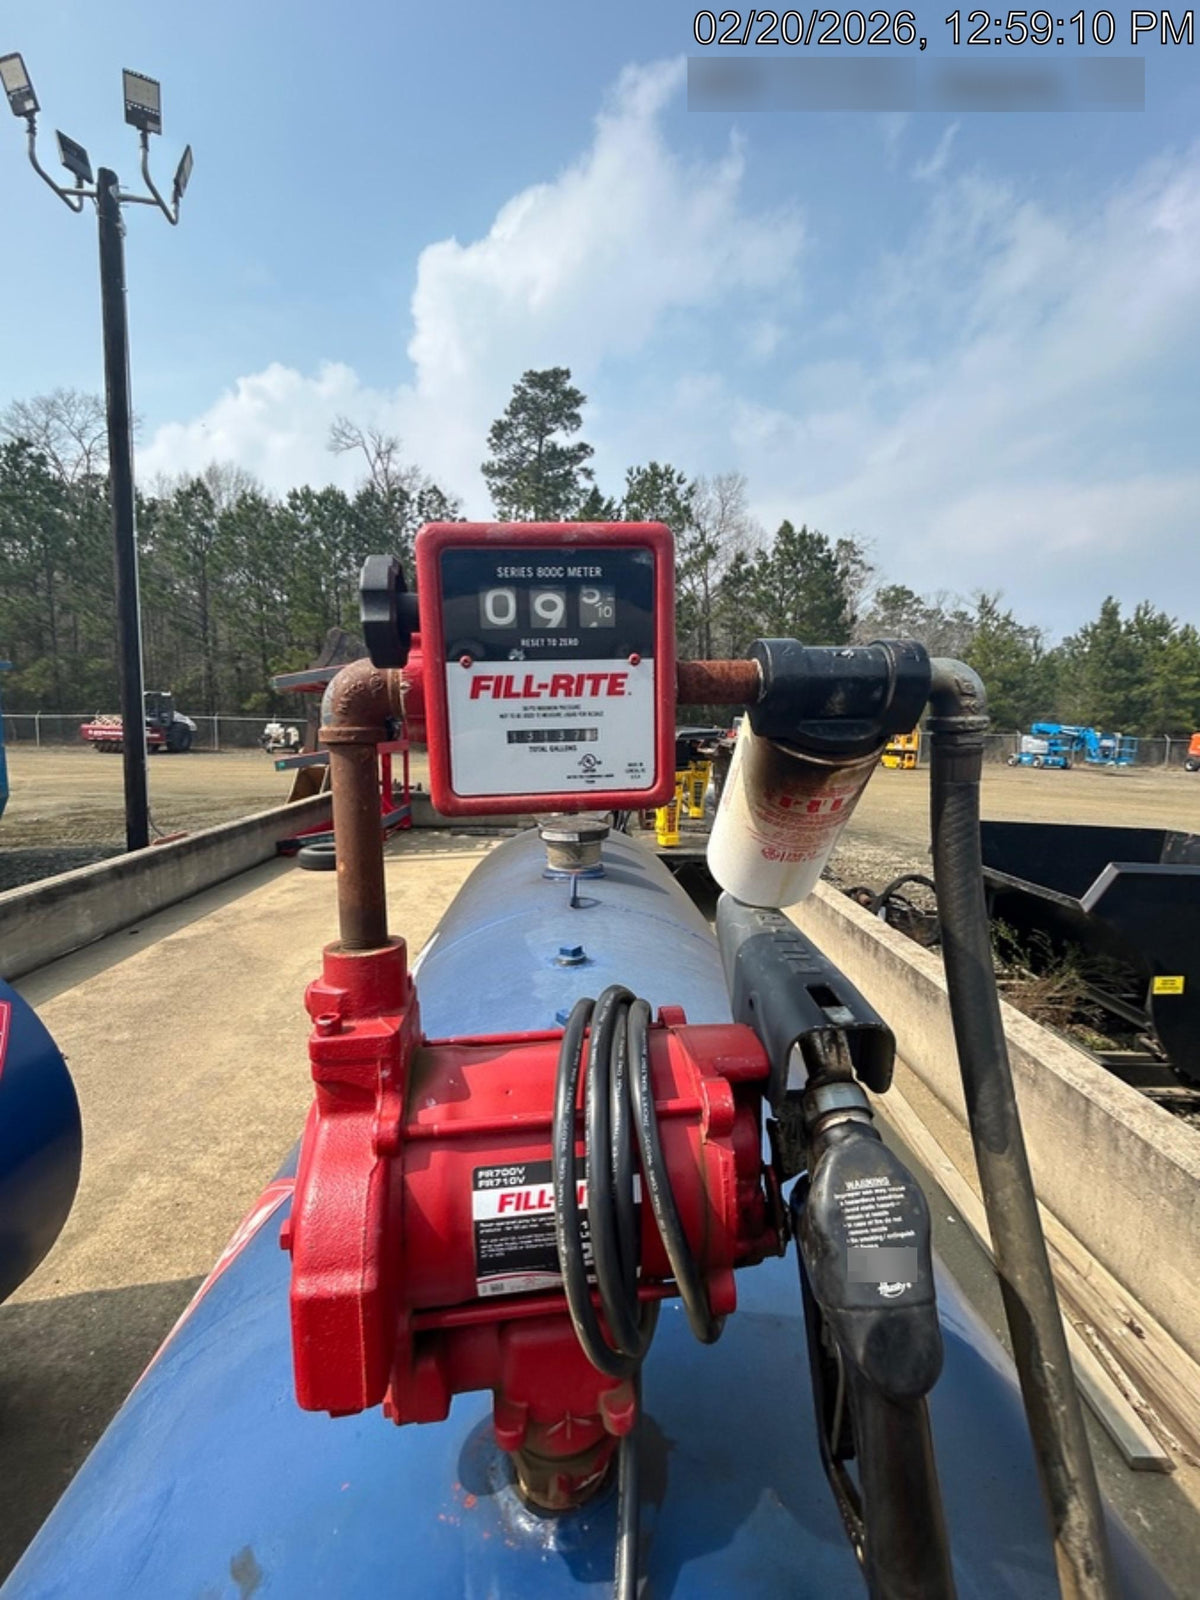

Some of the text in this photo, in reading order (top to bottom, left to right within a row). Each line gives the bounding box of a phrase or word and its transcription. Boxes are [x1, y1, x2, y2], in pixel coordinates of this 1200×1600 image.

[496, 566, 534, 578] SERIES
[567, 566, 603, 578] METER
[469, 671, 629, 700] FILL-RITE
[477, 1166, 526, 1179] FR700V
[477, 1176, 526, 1189] FR710V
